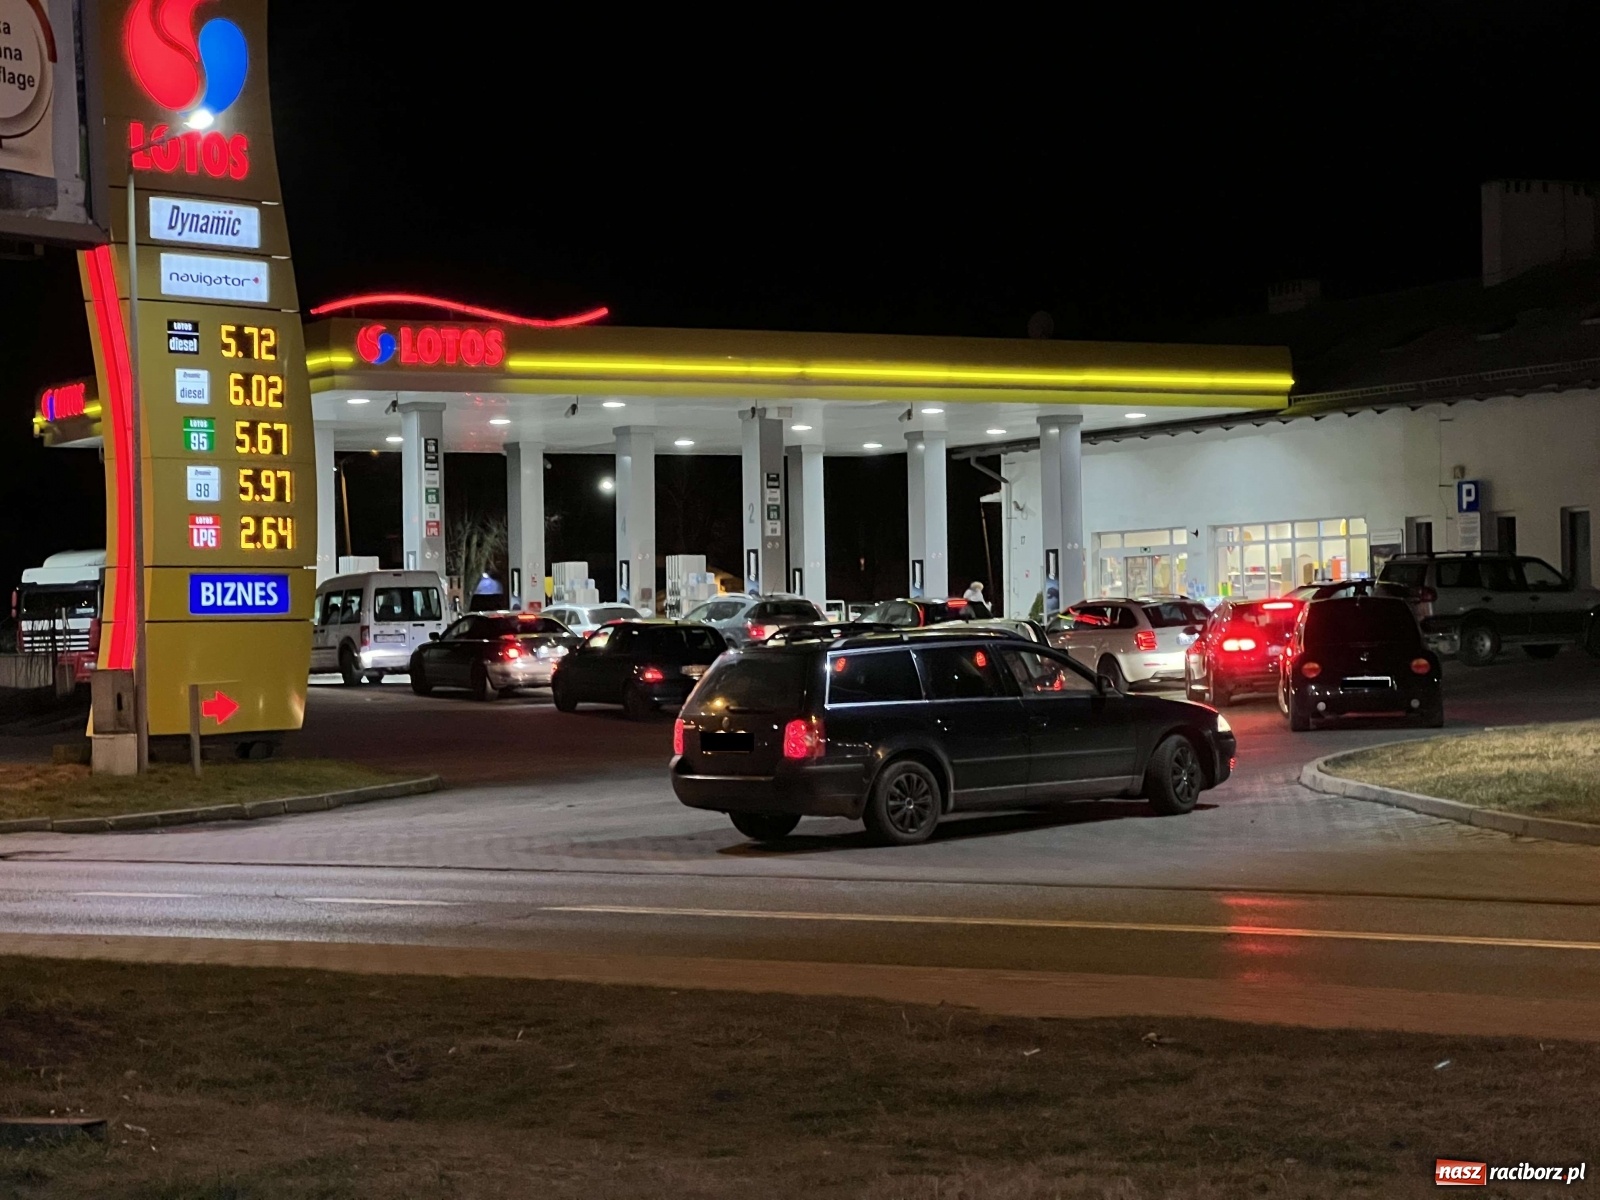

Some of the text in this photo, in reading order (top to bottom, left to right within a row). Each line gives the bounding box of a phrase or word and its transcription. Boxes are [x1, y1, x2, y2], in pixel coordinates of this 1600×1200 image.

[0, 20, 11, 35] a
[0, 66, 35, 91] lage
[130, 121, 249, 181] LOTOS
[167, 204, 241, 237] Dynamic
[169, 270, 250, 288] navigator
[169, 336, 198, 352] diesel
[220, 324, 276, 361] 5.72
[400, 326, 505, 367] LOTOS
[180, 387, 205, 400] diesel
[229, 372, 283, 408] 6.02
[190, 432, 209, 451] 95
[235, 420, 288, 455] 5.67
[195, 483, 210, 498] 98
[238, 468, 291, 503] 5.97
[1462, 483, 1476, 510] P
[748, 502, 755, 524] 2
[192, 528, 217, 548] LPG
[240, 516, 293, 550] 2.64
[201, 581, 279, 607] BIZNES
